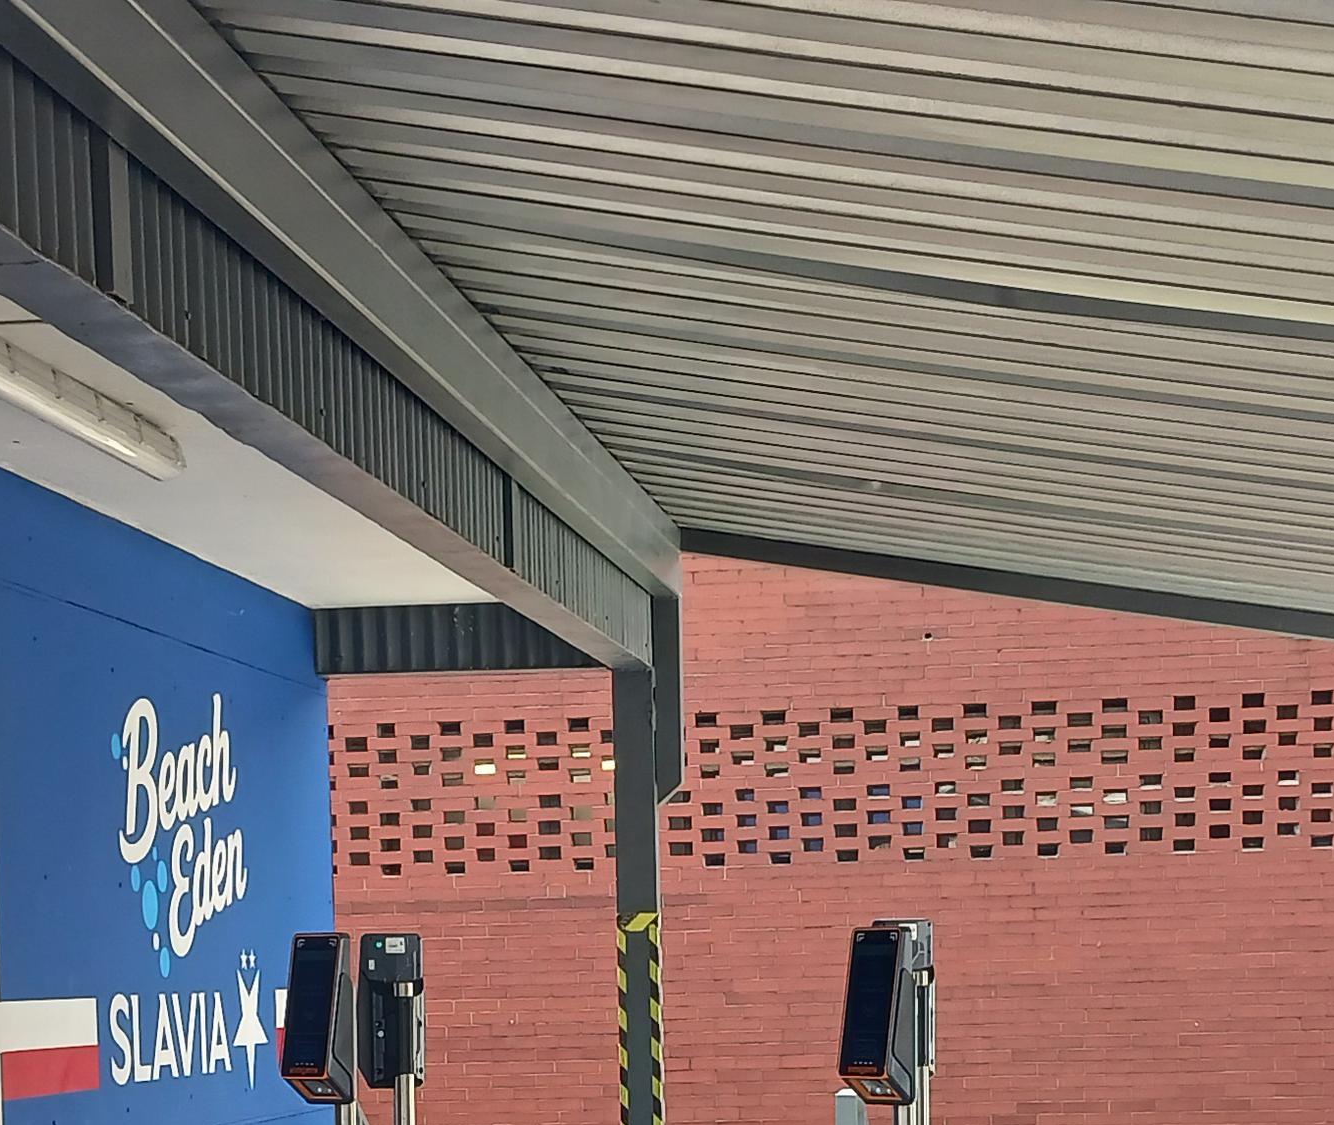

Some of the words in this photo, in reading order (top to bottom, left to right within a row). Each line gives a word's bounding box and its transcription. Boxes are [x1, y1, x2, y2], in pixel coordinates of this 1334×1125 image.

[118, 692, 237, 864] Beach
[168, 816, 248, 958] Eden
[109, 990, 233, 1087] SLAVIA
